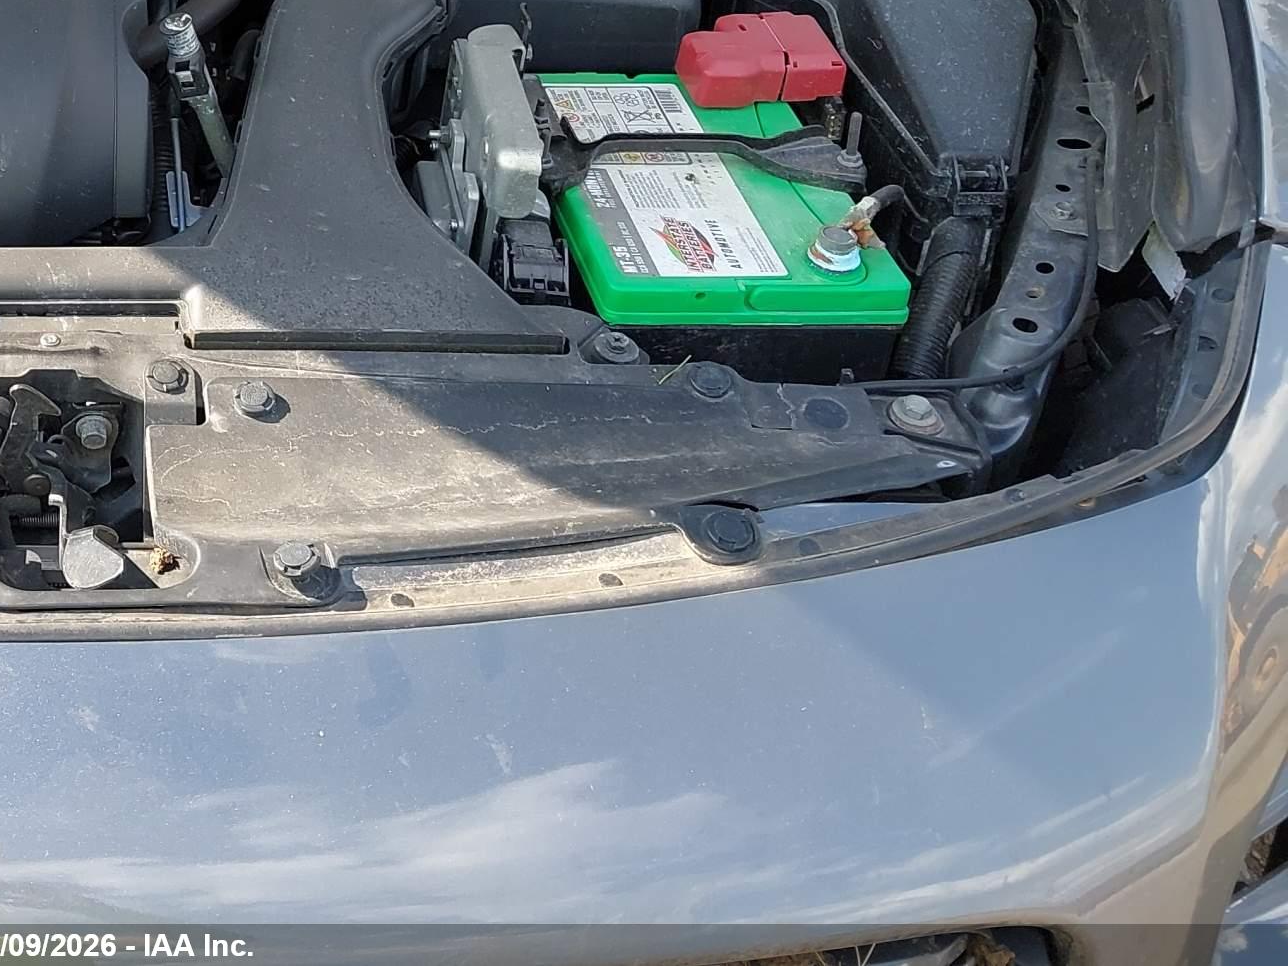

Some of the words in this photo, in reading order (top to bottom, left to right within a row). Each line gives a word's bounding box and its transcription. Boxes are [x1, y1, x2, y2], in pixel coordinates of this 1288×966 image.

[613, 245, 638, 273] MT-35
[663, 217, 700, 272] INTERSTATE
[679, 221, 712, 270] BATTERIES
[704, 219, 743, 270] AUTOMOTIVE
